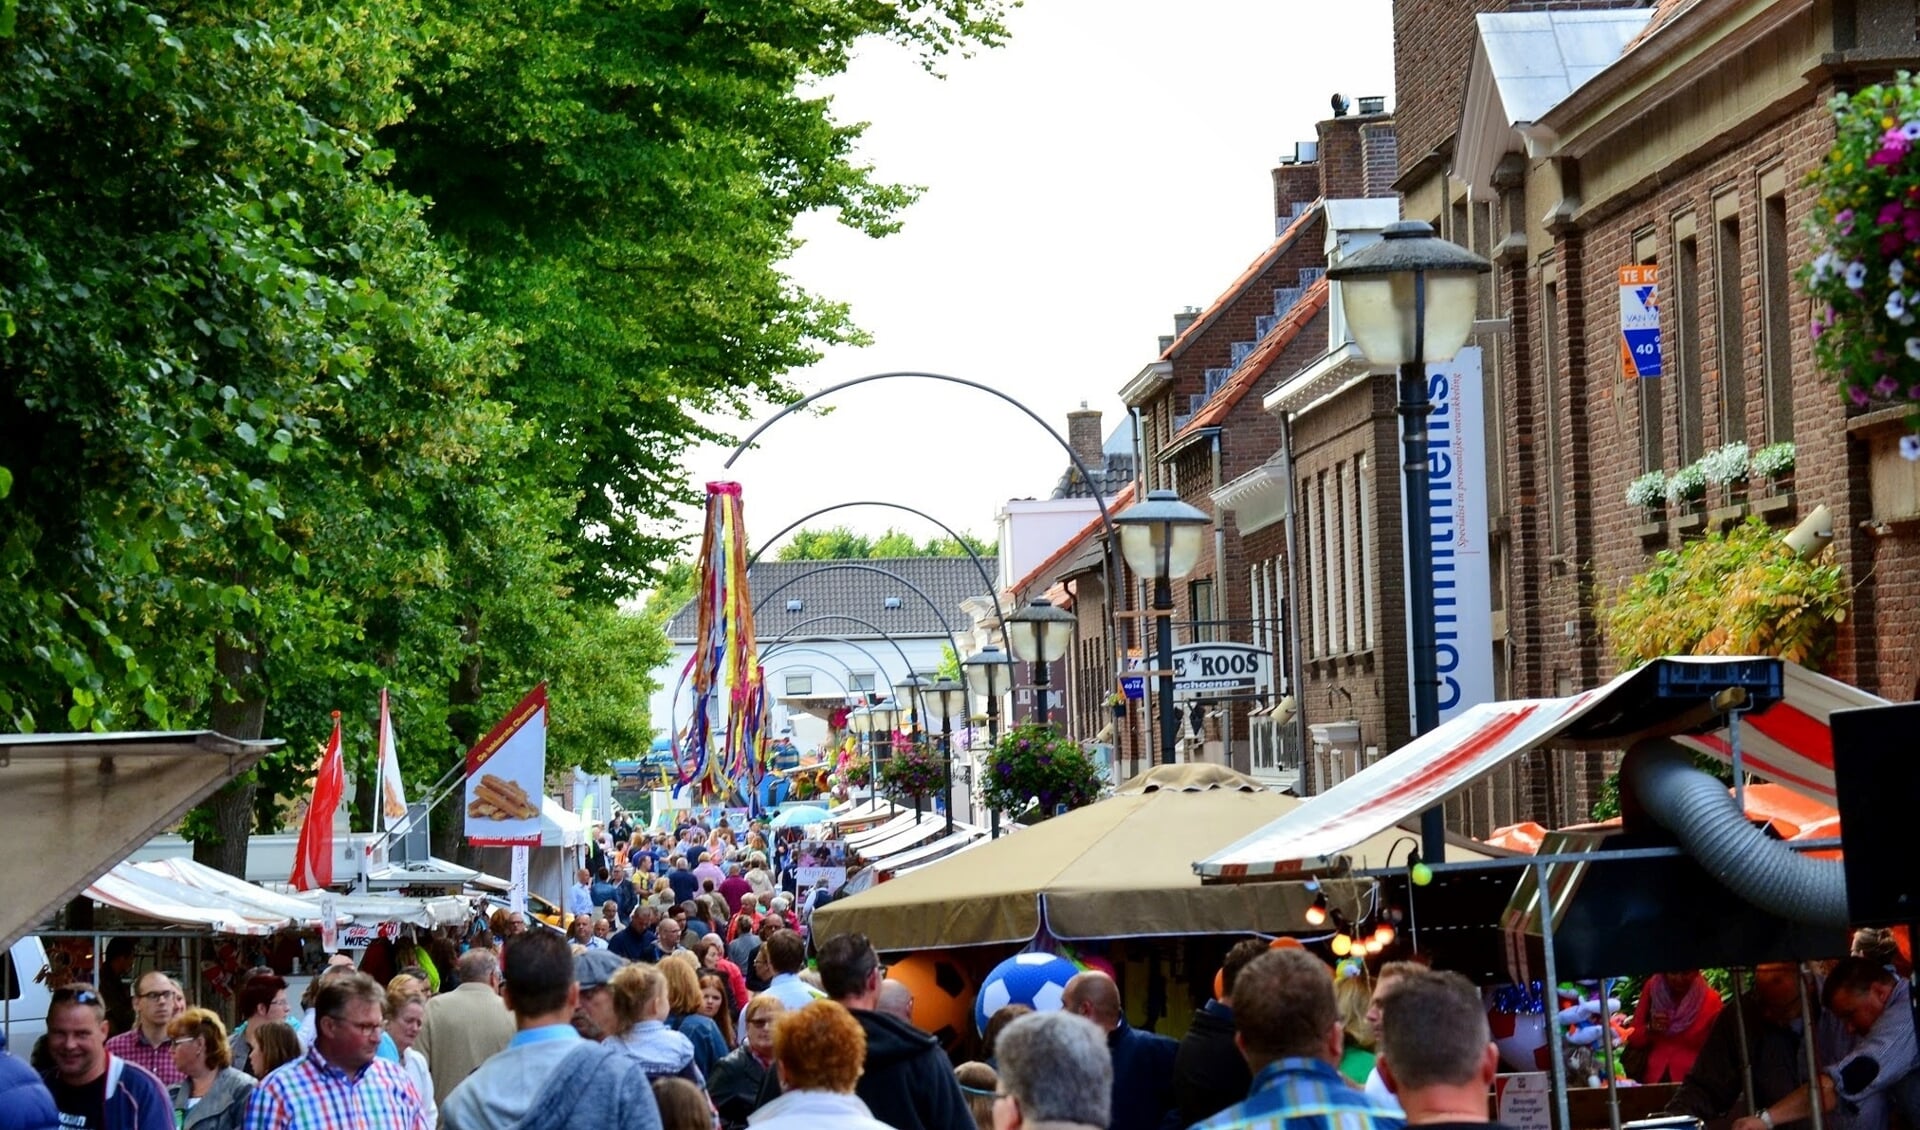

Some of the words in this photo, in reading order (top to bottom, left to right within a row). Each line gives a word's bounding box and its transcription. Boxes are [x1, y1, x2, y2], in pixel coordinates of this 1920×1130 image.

[1622, 269, 1638, 282] TE
[1643, 269, 1658, 281] K
[1636, 343, 1654, 354] 40
[1451, 372, 1464, 434] ontwikkeling
[1453, 435, 1467, 491] persoonlijke
[1456, 504, 1468, 548] Specialist
[1173, 657, 1187, 678] E
[1201, 653, 1259, 677] ROOS
[1175, 679, 1240, 690] schoenen
